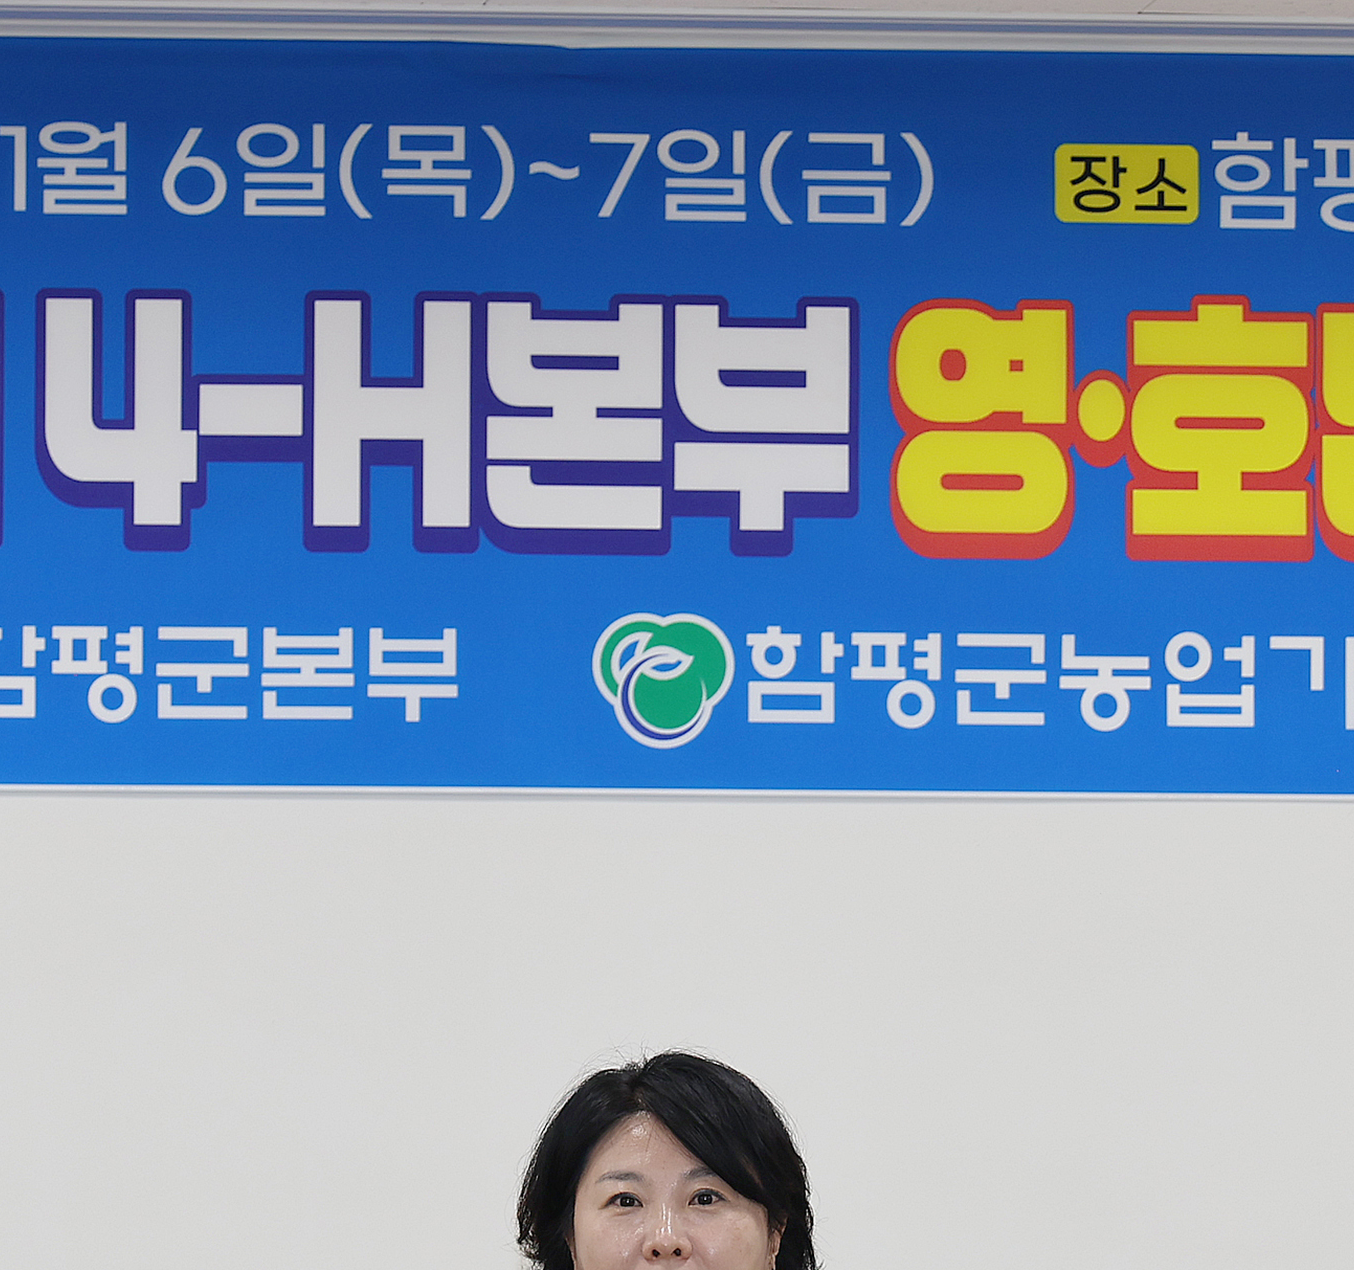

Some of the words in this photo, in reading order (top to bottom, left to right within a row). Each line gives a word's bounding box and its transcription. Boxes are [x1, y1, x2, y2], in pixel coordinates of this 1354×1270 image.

[162, 122, 936, 226] 6일(목)~7일(금)
[1068, 154, 1190, 215] 장소
[44, 297, 849, 532] 4-H본부
